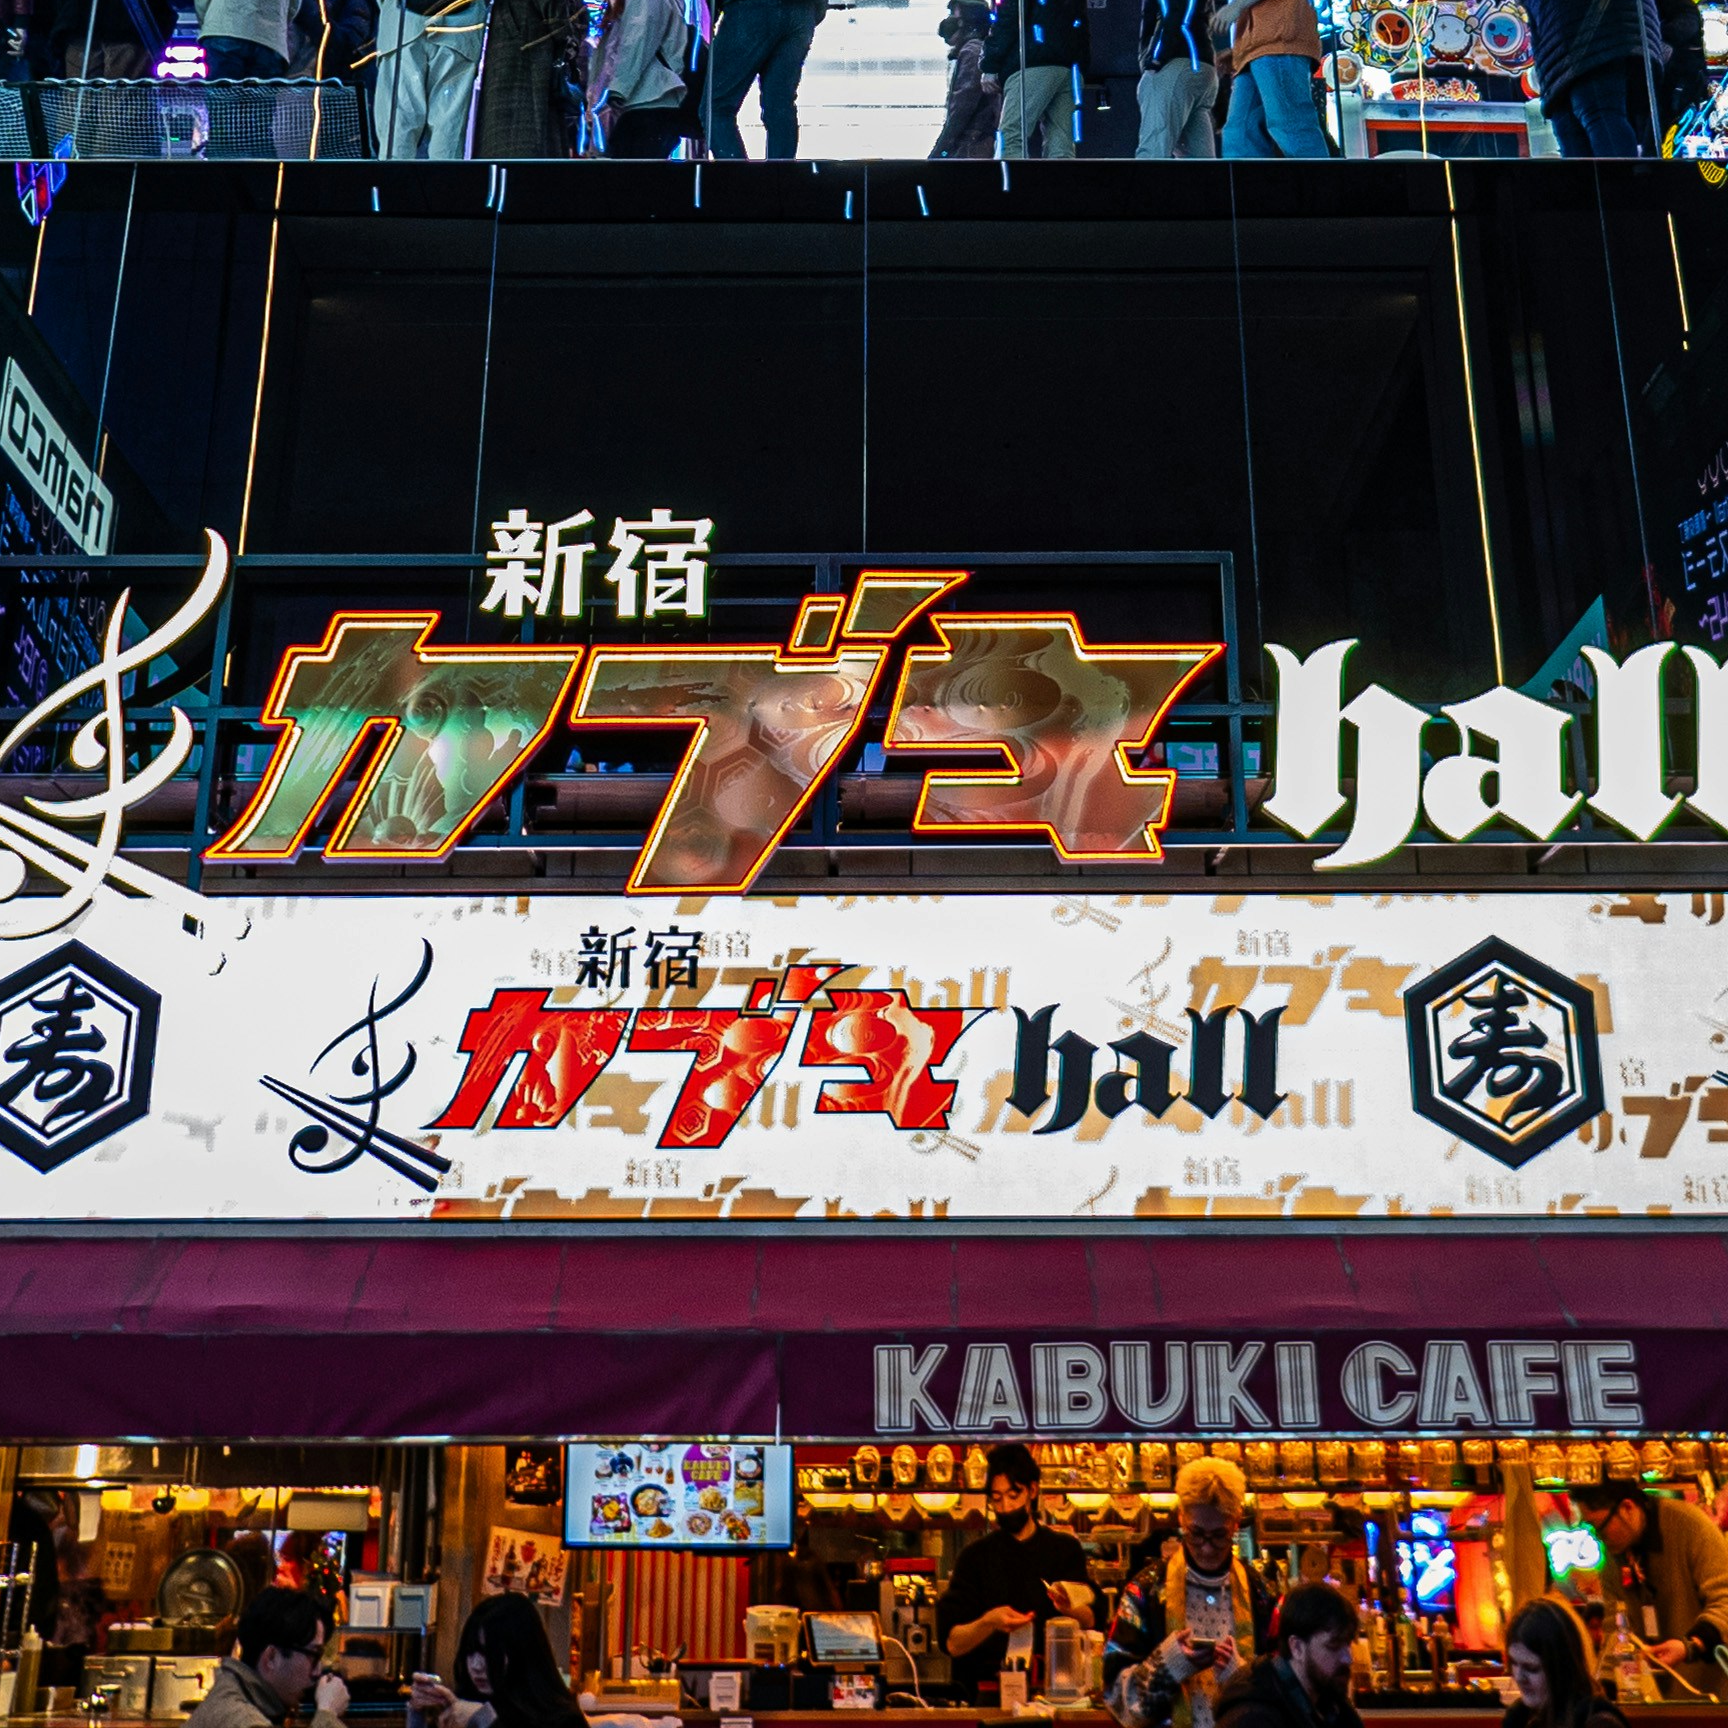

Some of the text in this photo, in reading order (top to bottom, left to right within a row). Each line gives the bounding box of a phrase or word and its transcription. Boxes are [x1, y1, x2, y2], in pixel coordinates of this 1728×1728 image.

[479, 507, 716, 619] 新宿
[575, 924, 705, 992] 新宿
[1005, 1001, 1289, 1137] hall
[872, 1338, 1644, 1434] KABUKI CAFE
